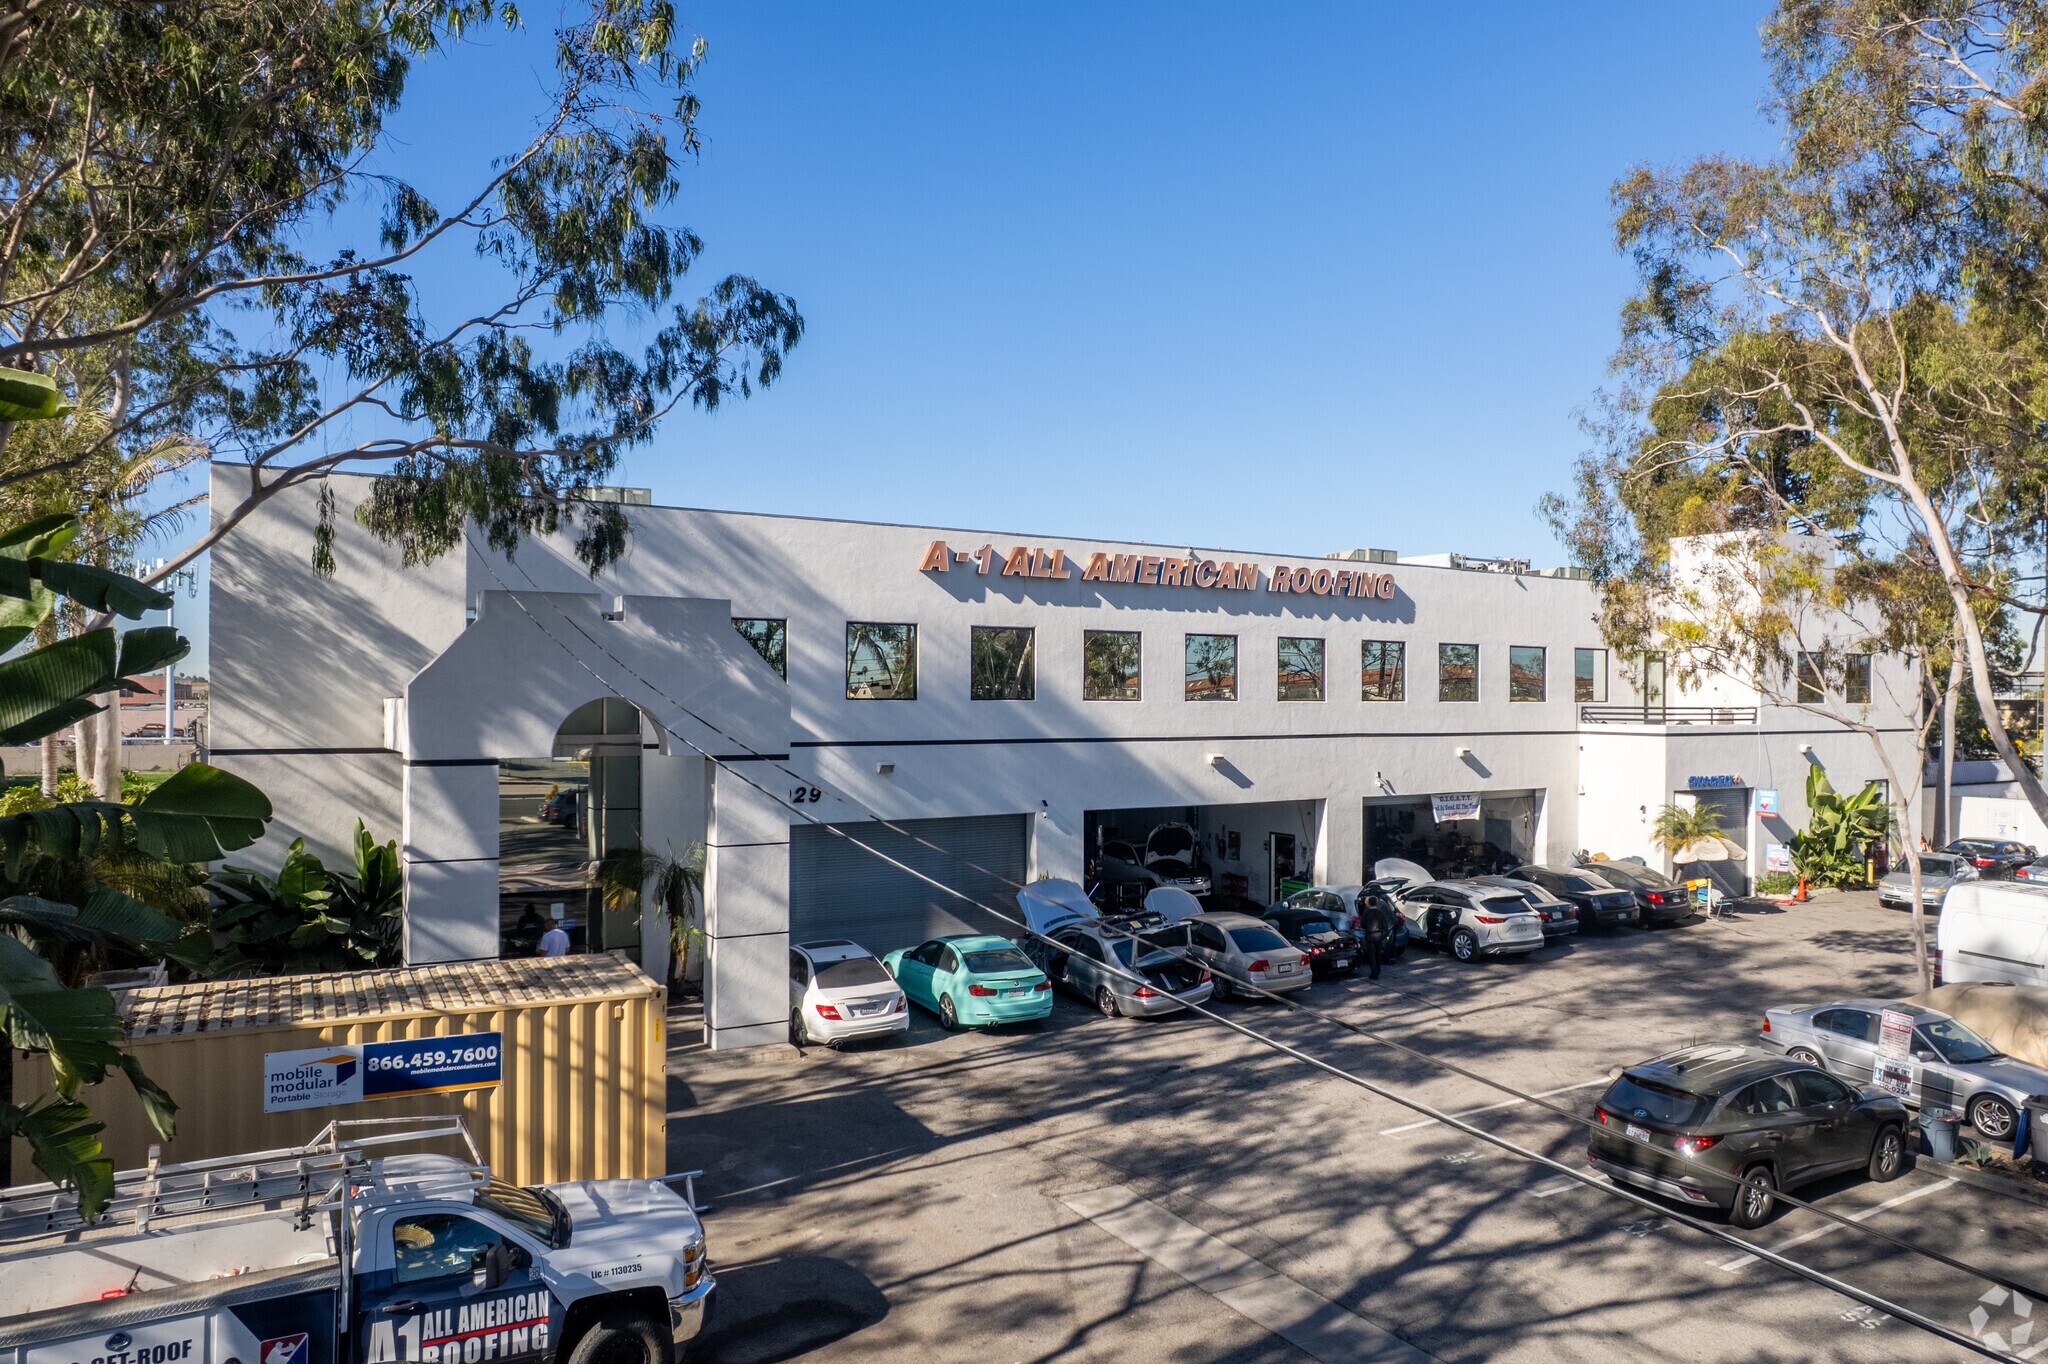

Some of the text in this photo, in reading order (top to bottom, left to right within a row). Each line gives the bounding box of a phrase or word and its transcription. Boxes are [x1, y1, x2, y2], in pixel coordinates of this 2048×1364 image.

[919, 540, 1396, 600] A-1 ALL AMERICAN ROOFING
[790, 786, 822, 803] 29
[367, 1046, 498, 1072] 866.459.7600
[271, 1066, 322, 1082] mobile
[410, 1061, 497, 1075] mobilemodularcontainers.com
[270, 1077, 333, 1094] modular
[270, 1088, 348, 1104] Portable Storage
[591, 1263, 642, 1279] Lic # 1130235
[423, 1290, 549, 1341] ALL AMERICAN
[368, 1314, 420, 1364] A1
[422, 1323, 549, 1364] ROOFING
